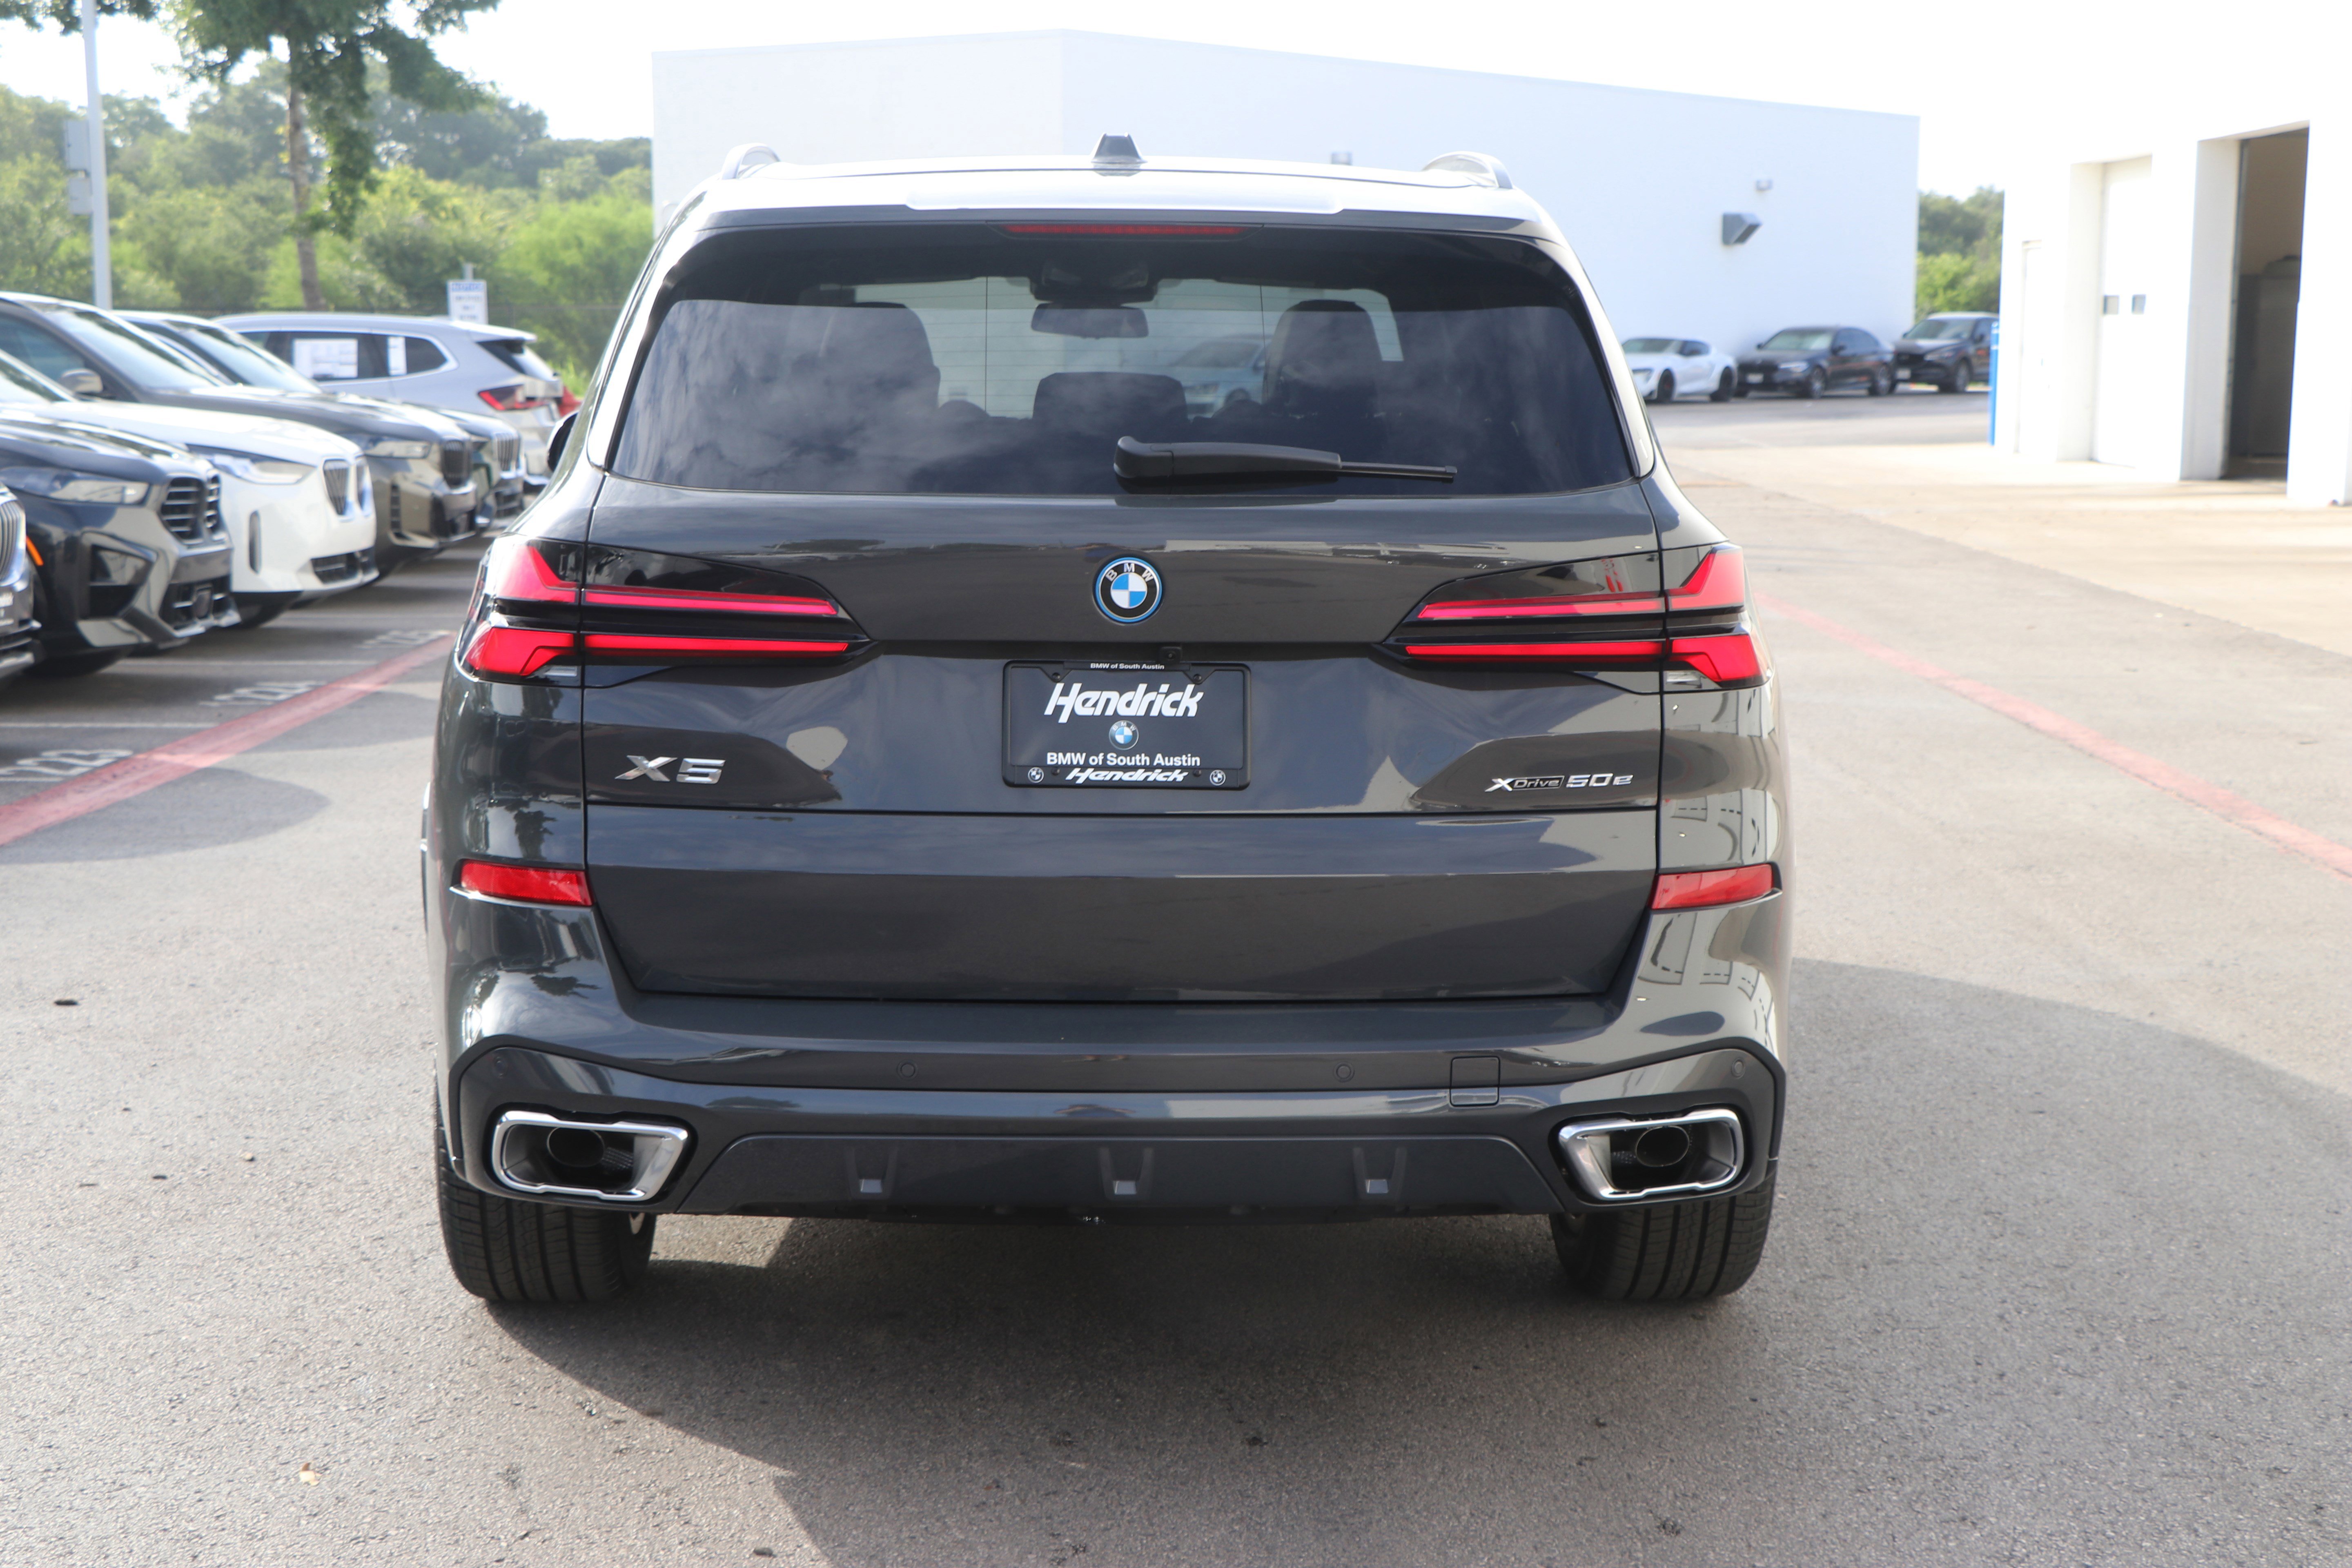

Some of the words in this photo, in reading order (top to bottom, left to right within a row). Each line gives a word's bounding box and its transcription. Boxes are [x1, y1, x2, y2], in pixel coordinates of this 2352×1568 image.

[1105, 563, 1154, 582] BMW
[1044, 683, 1204, 723] Hendrick
[1112, 721, 1136, 731] BMW
[1047, 752, 1086, 766] BMW
[1089, 753, 1104, 765] of
[1106, 753, 1150, 766] South
[1154, 753, 1200, 766] Austin
[615, 755, 726, 784] X5
[1065, 768, 1189, 784] Hendrick
